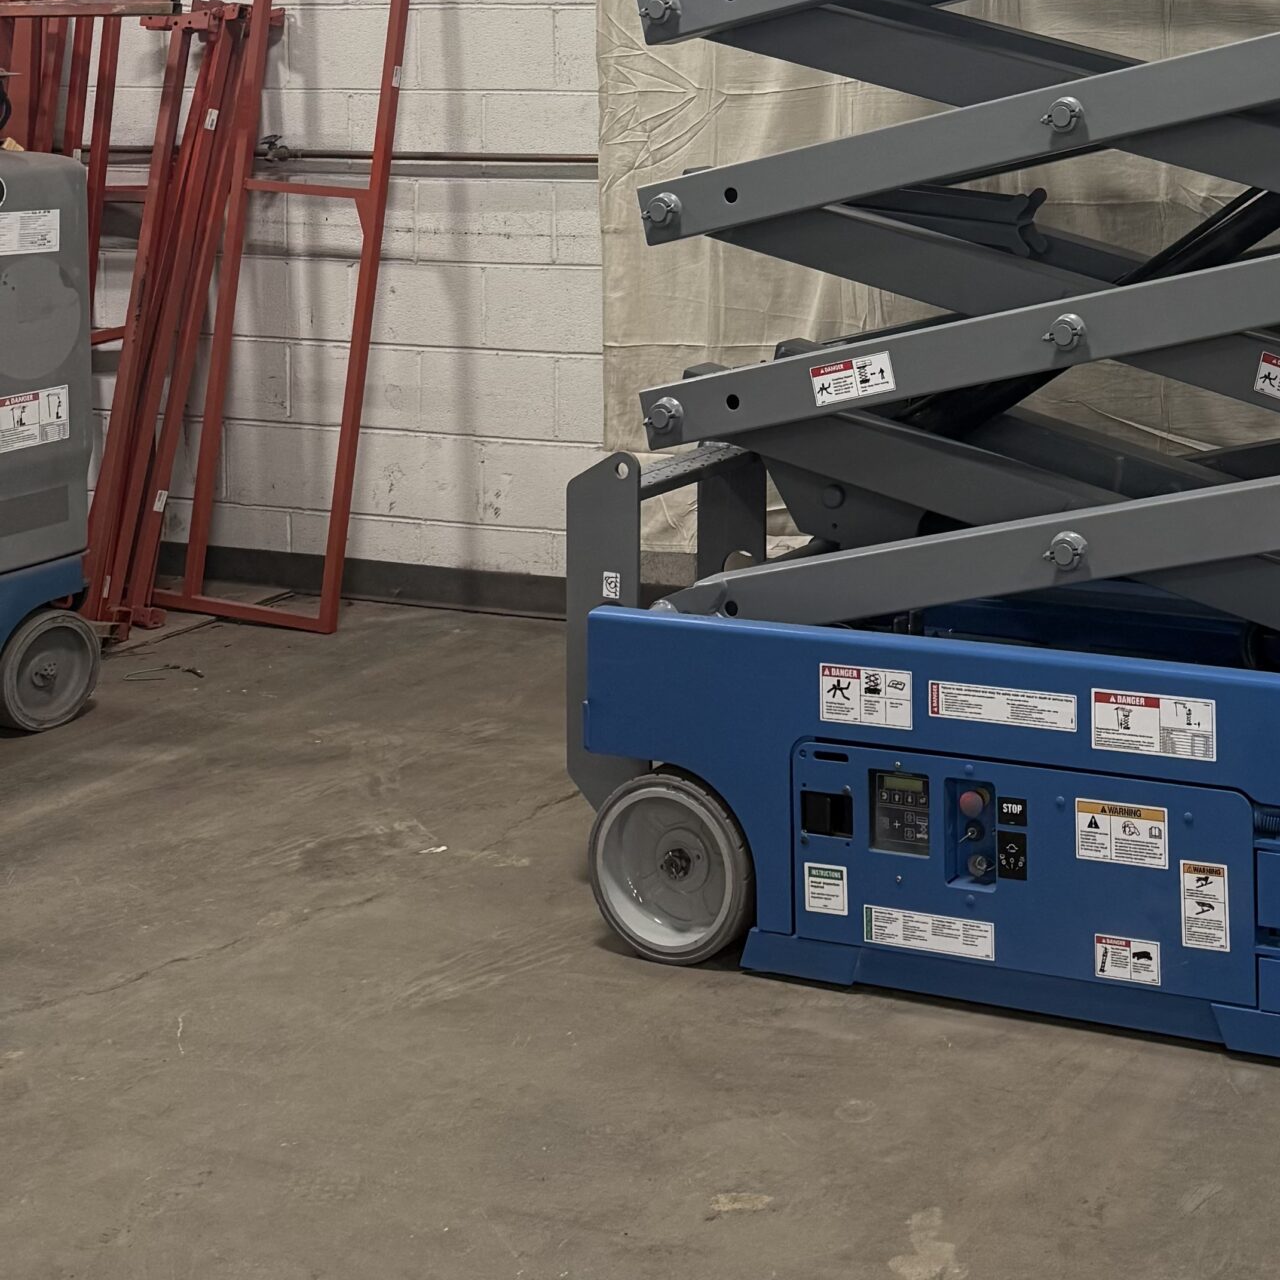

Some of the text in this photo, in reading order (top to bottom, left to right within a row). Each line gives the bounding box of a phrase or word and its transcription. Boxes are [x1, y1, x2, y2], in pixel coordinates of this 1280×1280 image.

[825, 363, 844, 372] DANGER
[831, 667, 858, 678] DANGER
[1117, 695, 1145, 706] DANGER
[1002, 803, 1023, 814] STOP
[1107, 806, 1142, 818] WARNING
[1193, 866, 1221, 875] WARNING
[1106, 938, 1126, 946] DANGER
